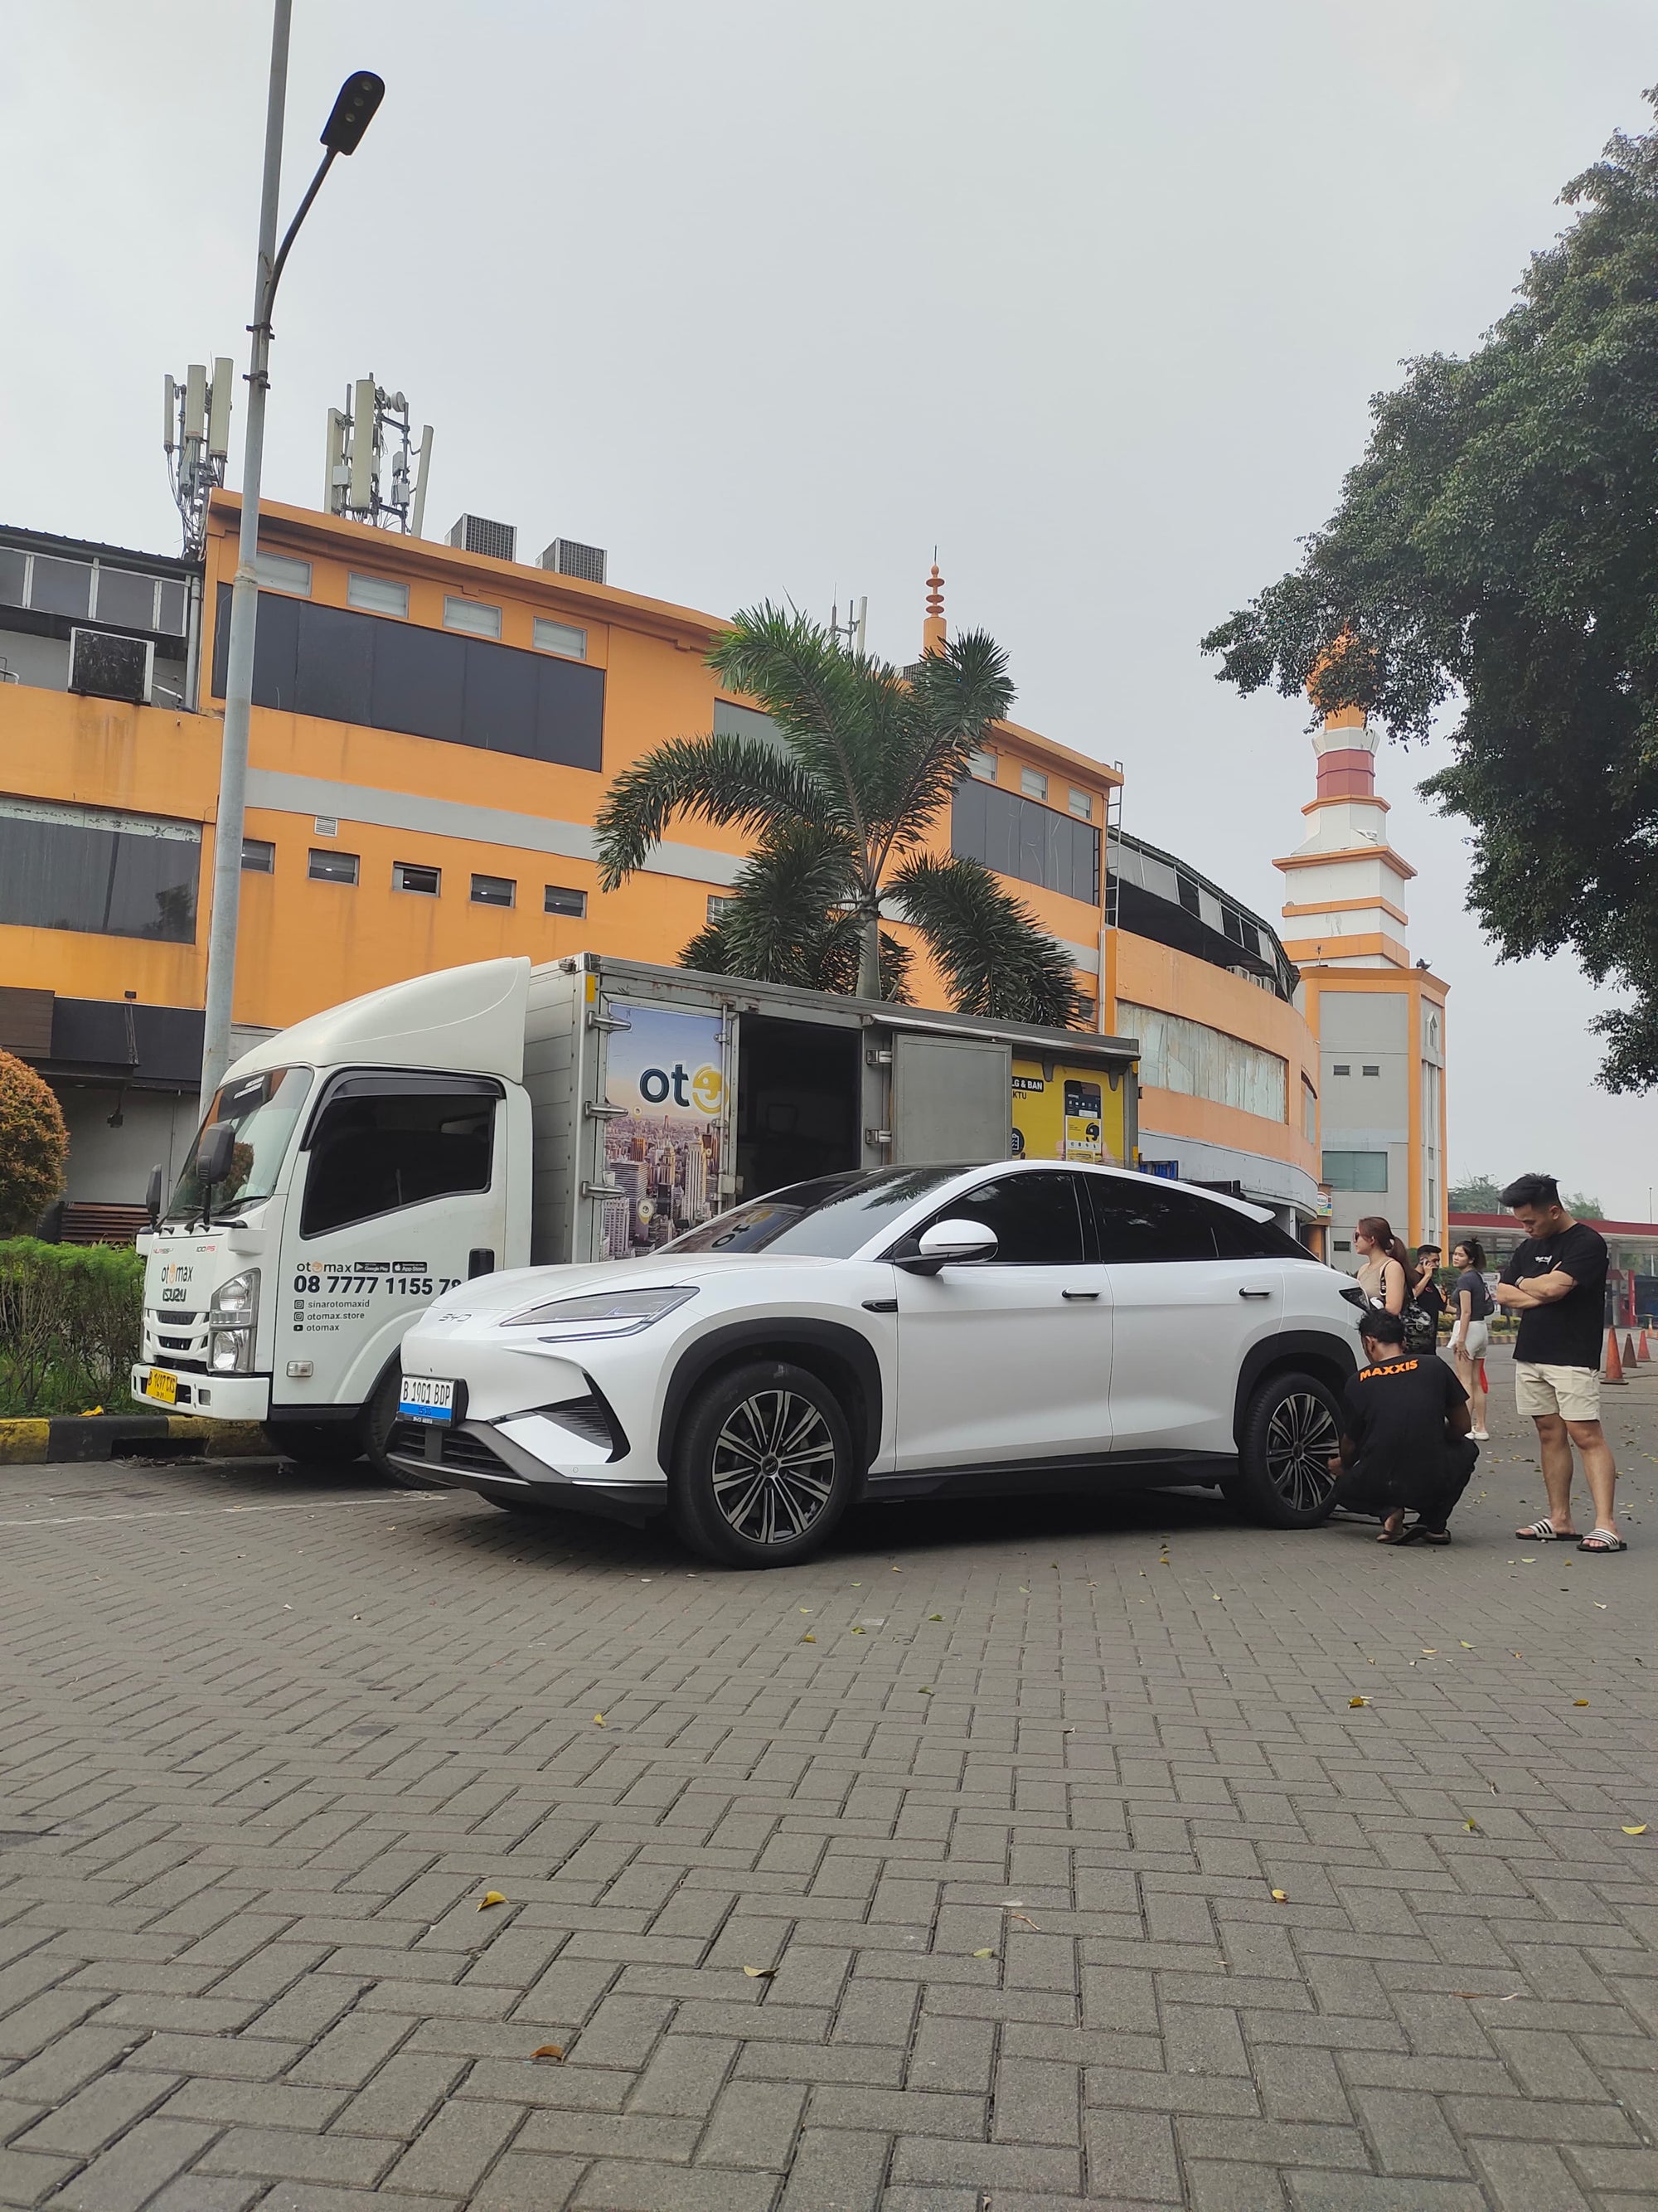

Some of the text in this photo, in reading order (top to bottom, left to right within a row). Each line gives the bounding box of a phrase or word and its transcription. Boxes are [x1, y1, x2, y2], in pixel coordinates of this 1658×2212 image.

[1020, 1079, 1026, 1089] &
[1028, 1080, 1043, 1090] BAN
[1013, 1090, 1027, 1099] KTU
[297, 1261, 352, 1273] otomax
[293, 1275, 321, 1293] 08
[327, 1276, 379, 1294] 7777
[385, 1277, 434, 1295] 1155
[162, 1288, 187, 1302] ISUZU
[308, 1299, 370, 1308] sinarotomaxid
[439, 1313, 472, 1322] BYD
[1360, 1359, 1419, 1382] MAXXIS
[403, 1380, 451, 1406] B 1901 BDP
